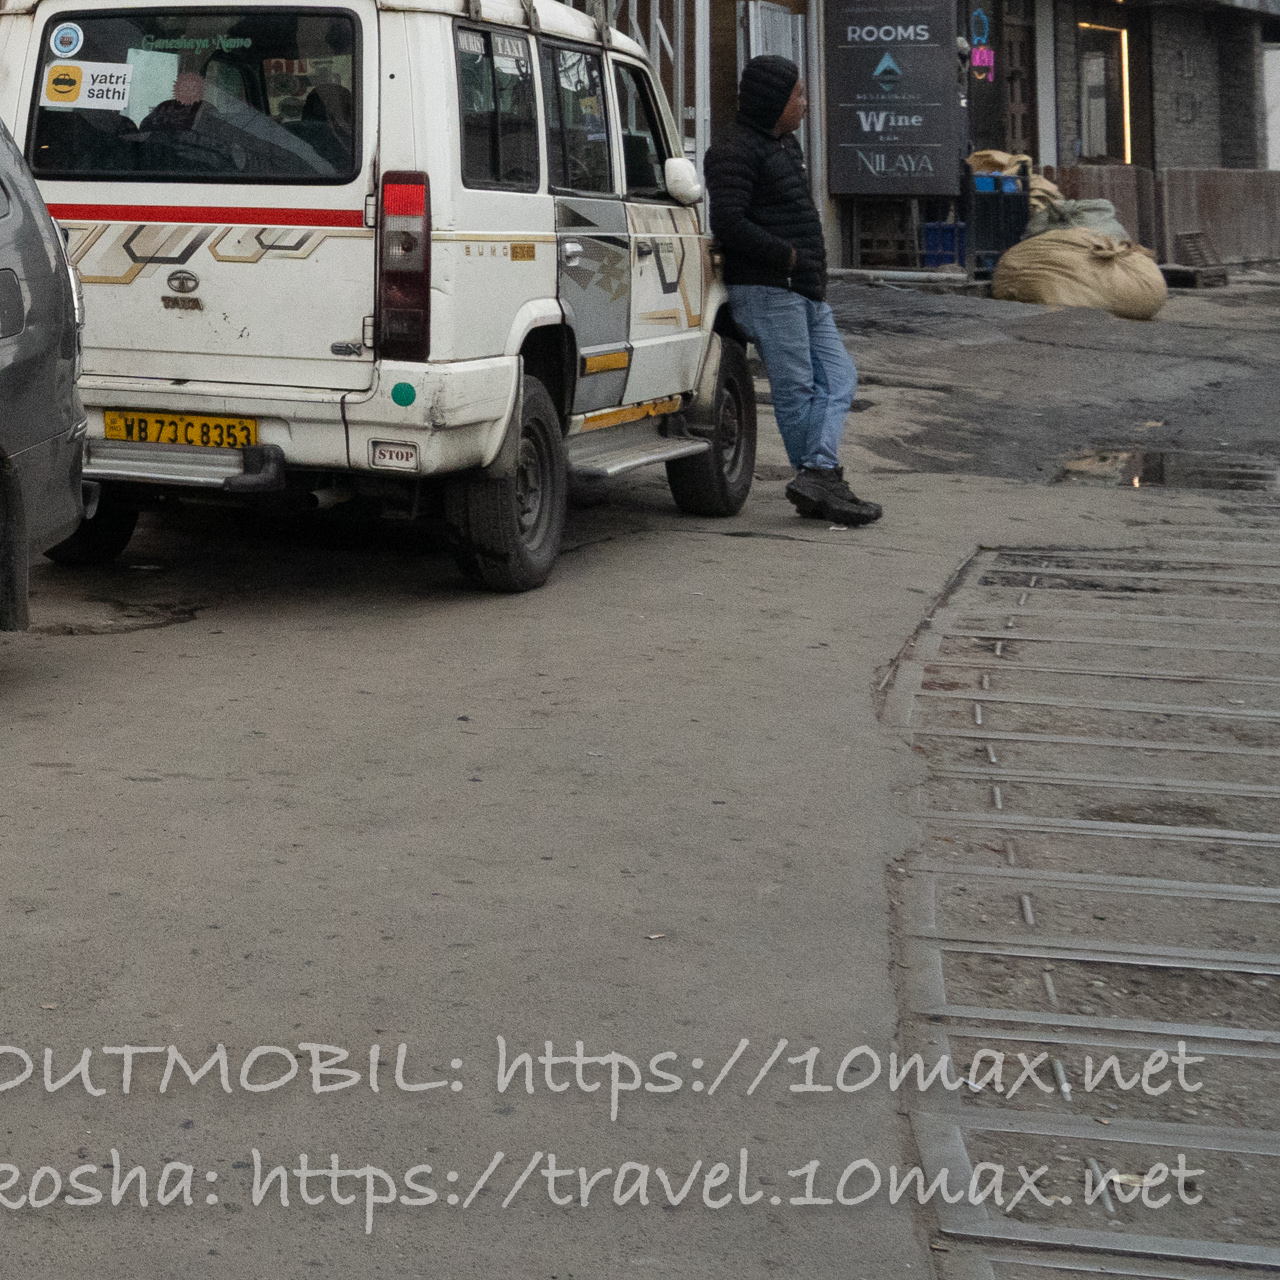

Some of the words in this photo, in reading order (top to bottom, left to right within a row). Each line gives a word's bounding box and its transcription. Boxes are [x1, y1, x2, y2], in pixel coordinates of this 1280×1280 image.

[847, 24, 930, 42] ROOMS
[494, 36, 525, 58] TAXI
[89, 73, 128, 86] yatri
[86, 87, 126, 101] sathi
[856, 110, 924, 132] Wine
[856, 150, 934, 175] NILAYA
[378, 448, 414, 462] STOP
